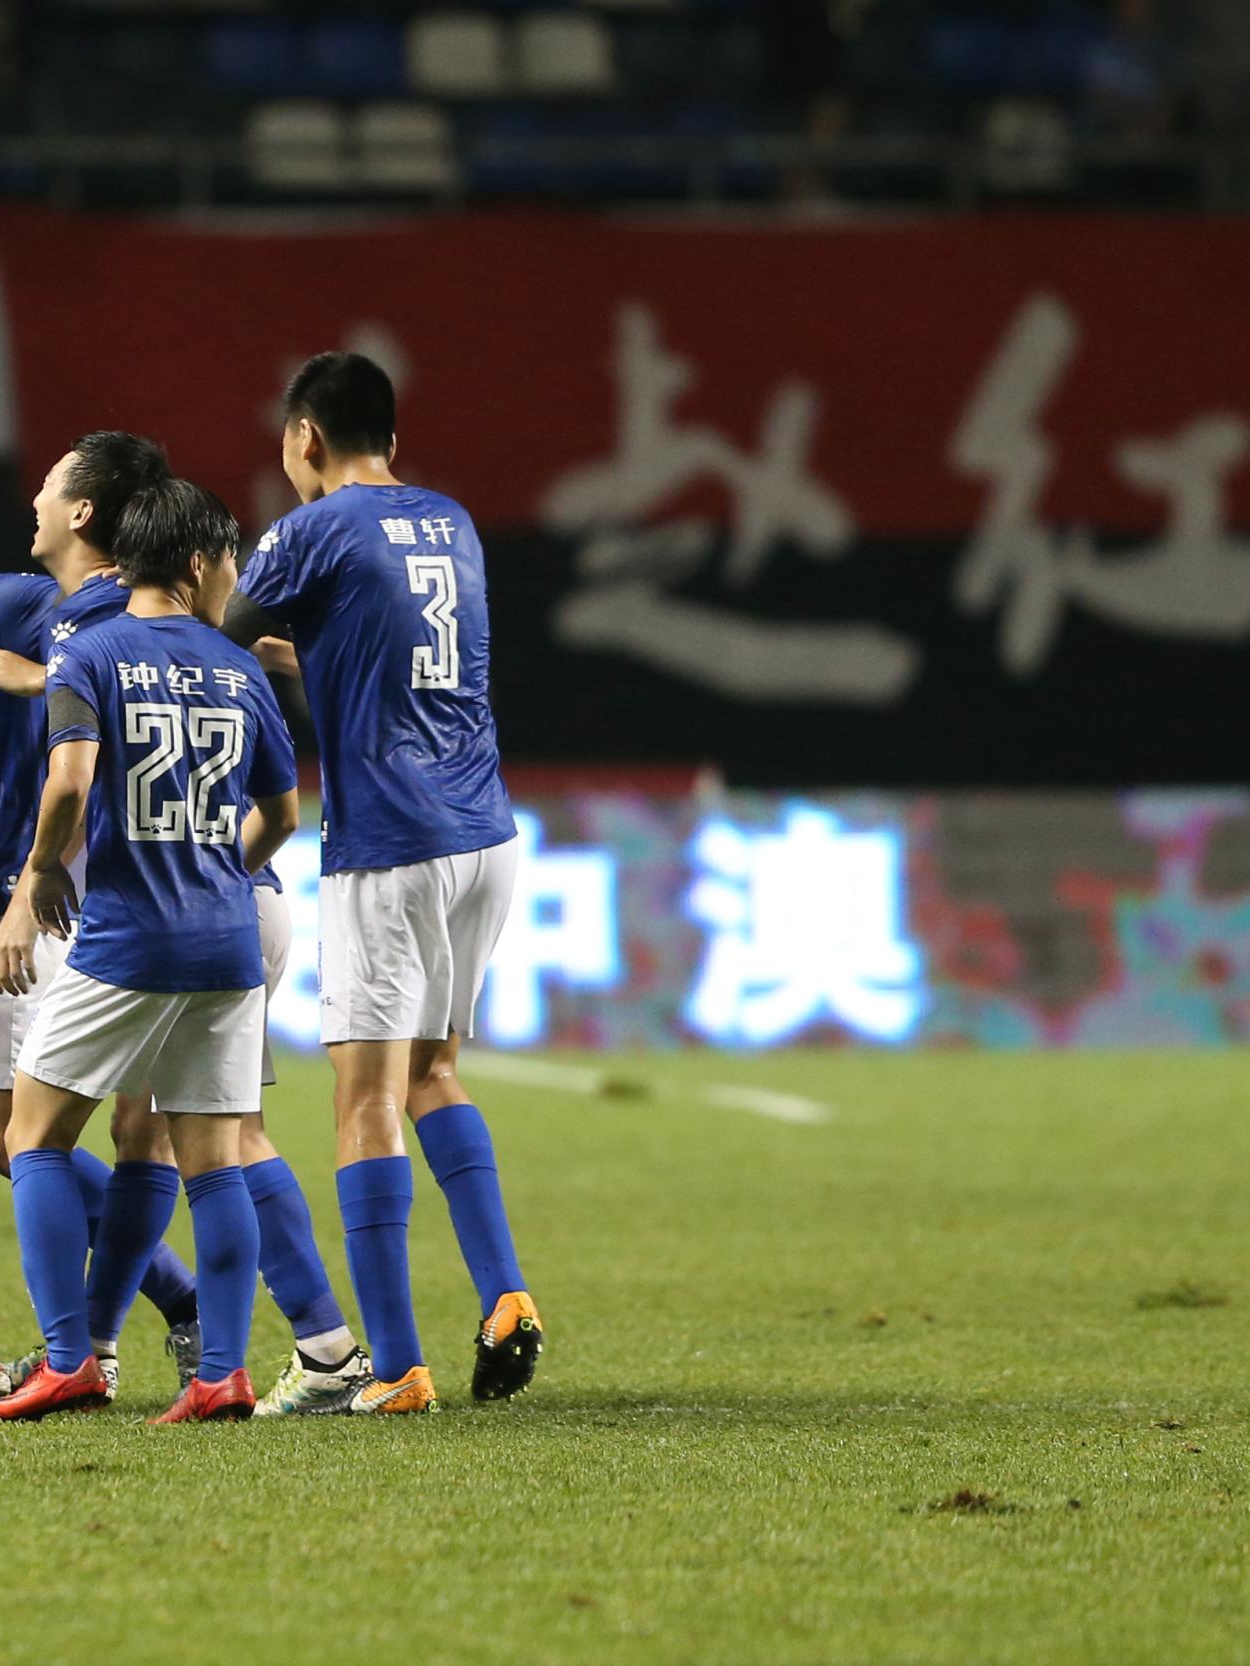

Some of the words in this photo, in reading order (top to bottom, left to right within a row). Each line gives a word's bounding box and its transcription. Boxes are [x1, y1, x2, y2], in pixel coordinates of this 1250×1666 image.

[379, 518, 455, 545] 曹轩
[405, 555, 459, 689] 3
[117, 662, 248, 697] 钟纪宇
[125, 703, 244, 845] 22
